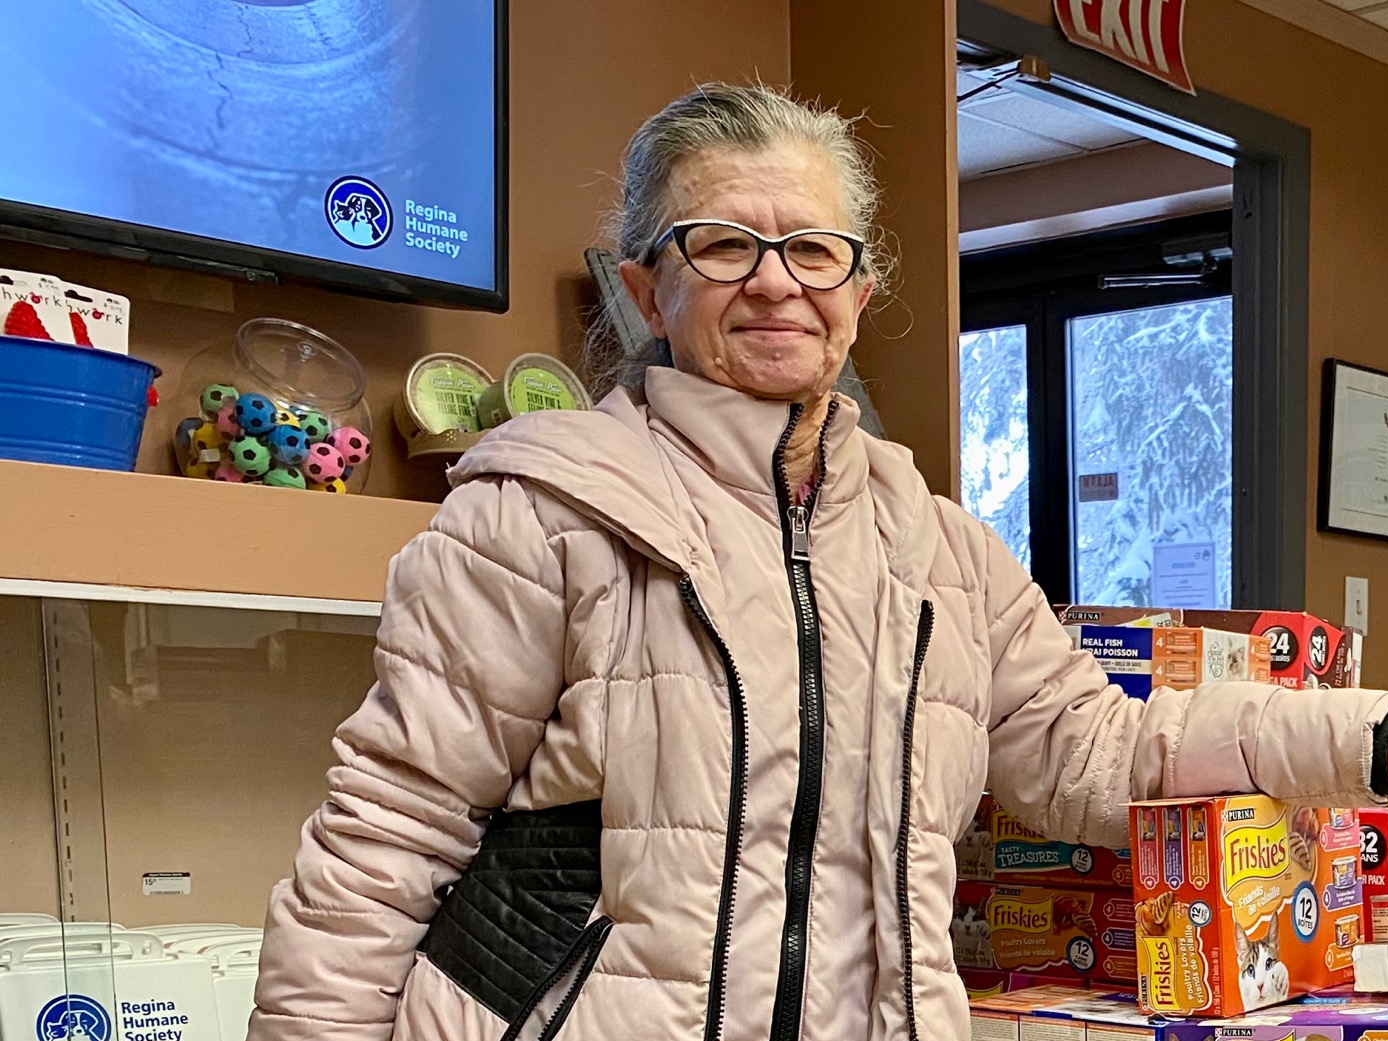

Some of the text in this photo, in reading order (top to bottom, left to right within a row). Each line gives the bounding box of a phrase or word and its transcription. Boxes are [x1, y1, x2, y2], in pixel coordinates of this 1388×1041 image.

[406, 199, 456, 223] Regina
[406, 215, 468, 241] Humane
[406, 232, 460, 258] Society
[998, 851, 1059, 867] TREASURES
[1230, 835, 1286, 871] Friskies
[993, 905, 1047, 927] Friskies
[1300, 897, 1312, 919] 12
[1154, 942, 1173, 1005] Friskies
[1180, 938, 1194, 1000] Poultry Lovers
[121, 999, 175, 1015] Regina
[123, 1014, 188, 1029] Humane
